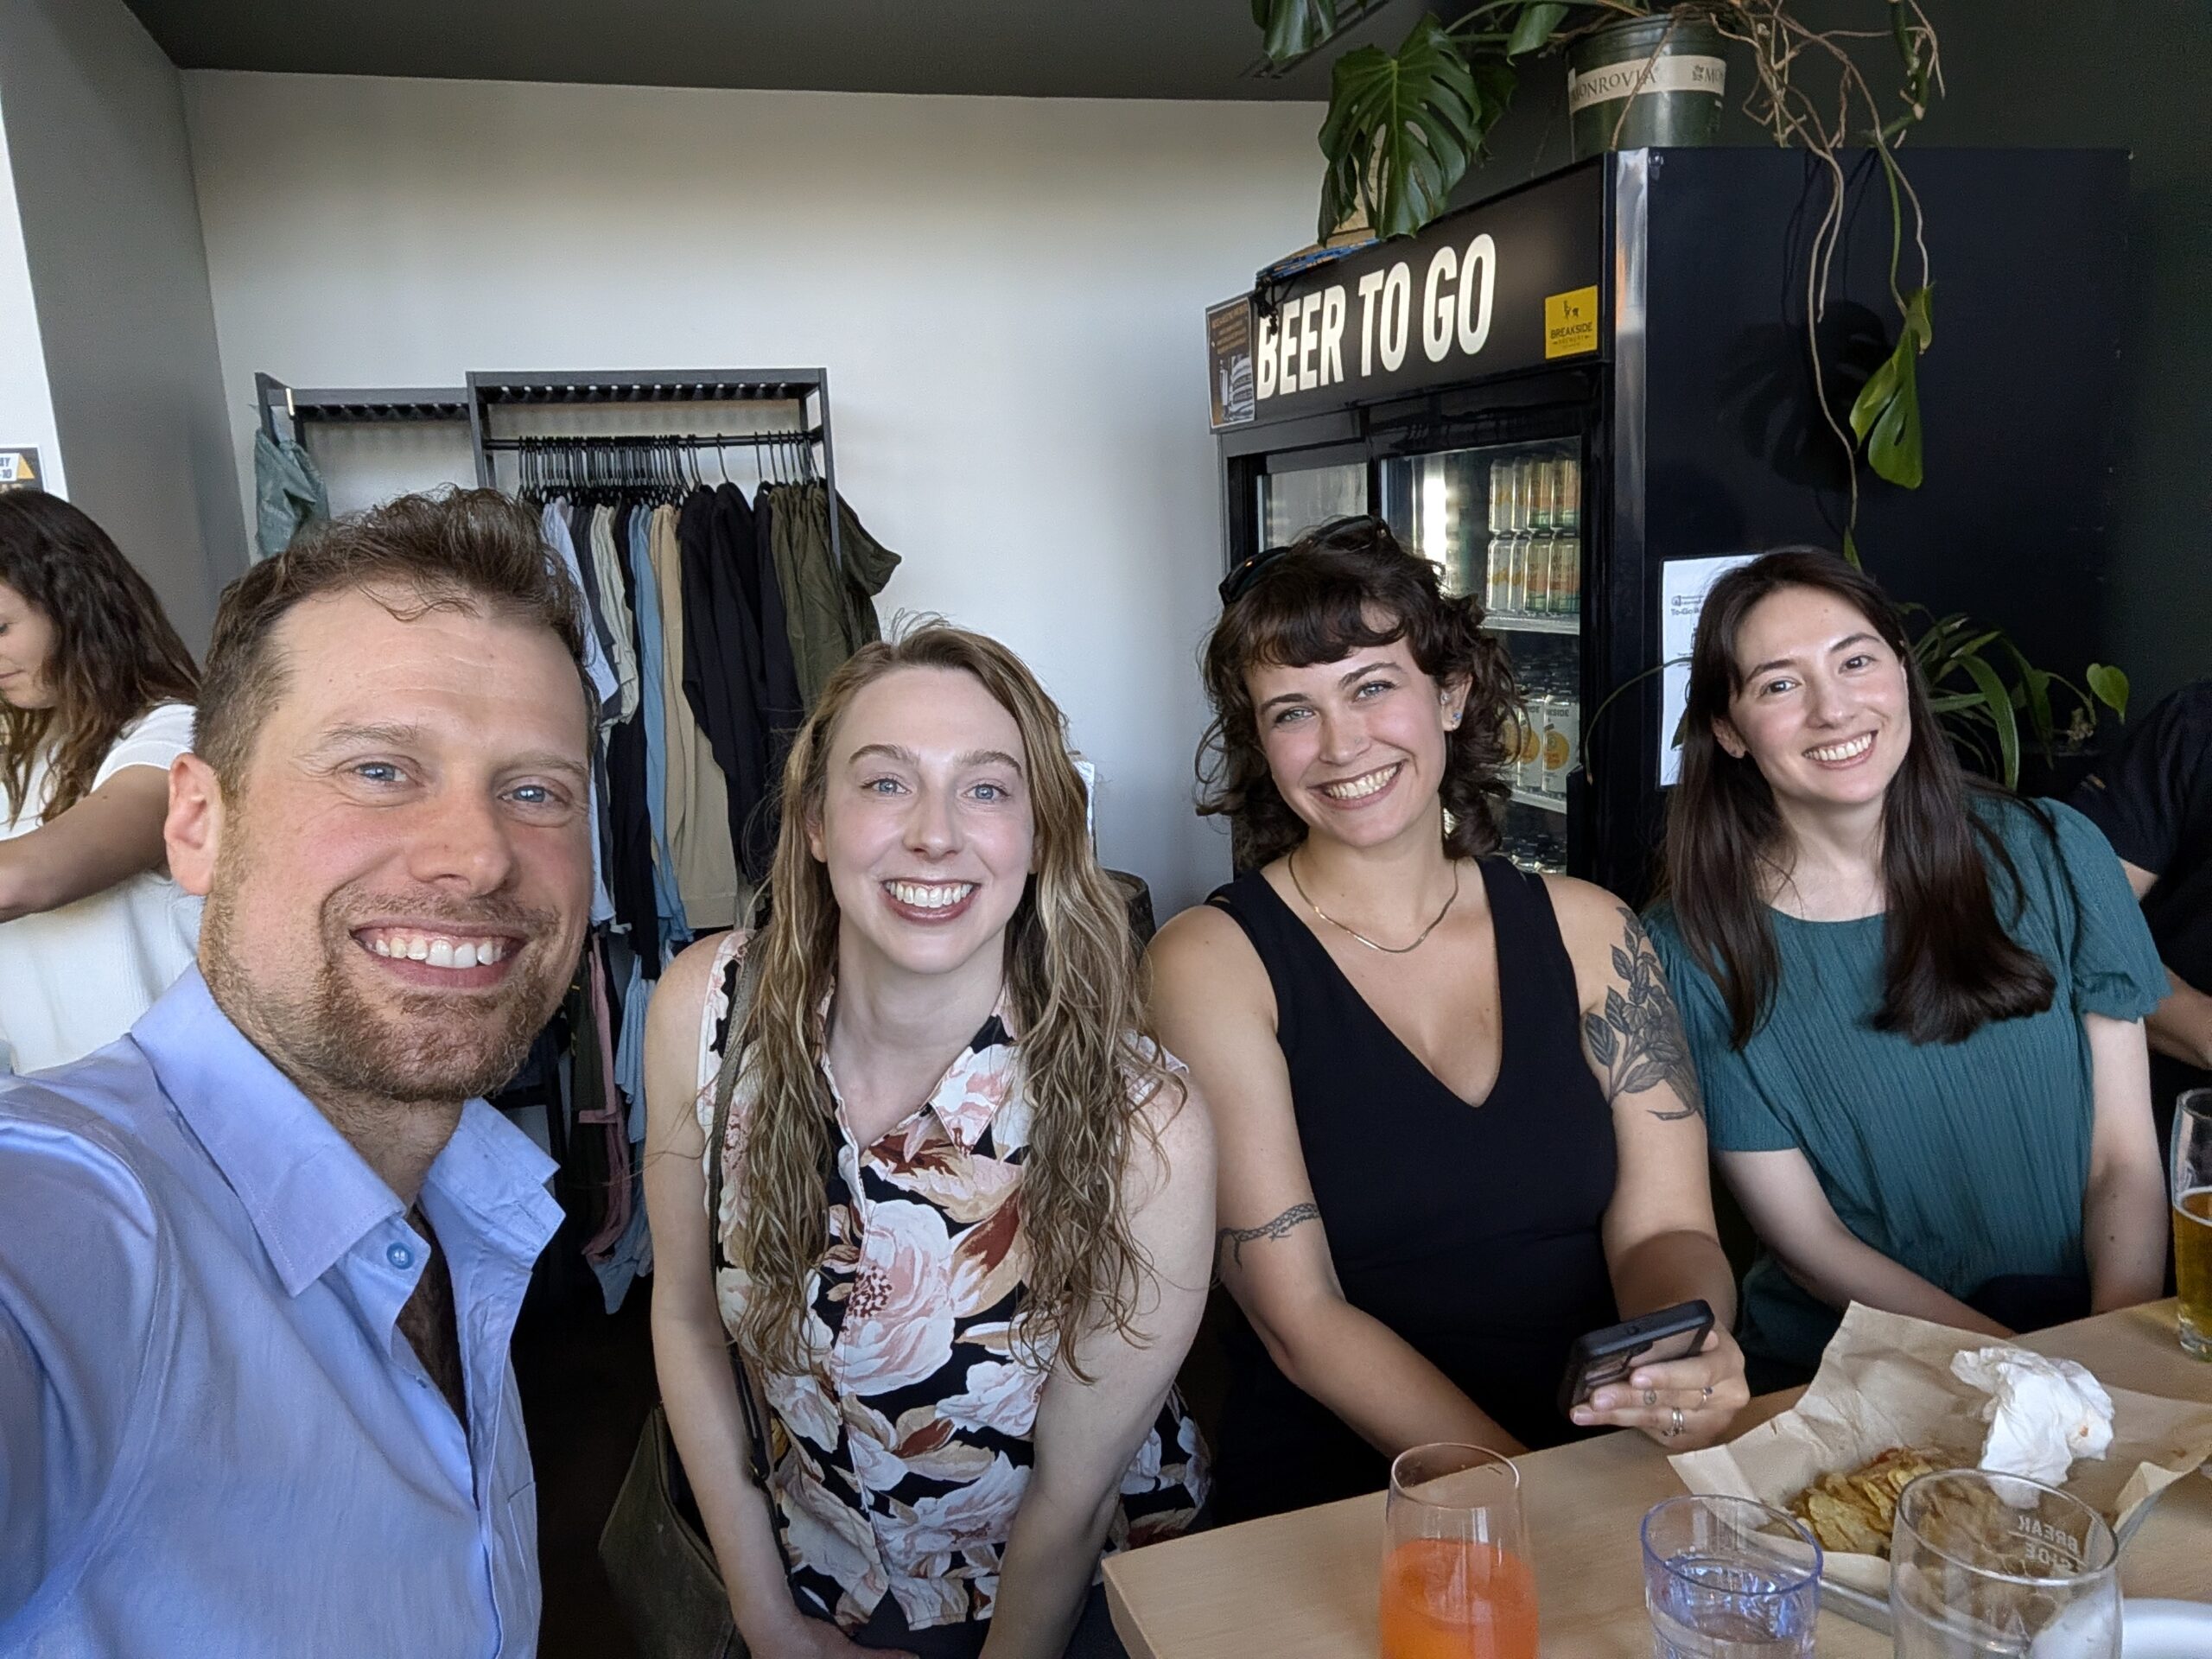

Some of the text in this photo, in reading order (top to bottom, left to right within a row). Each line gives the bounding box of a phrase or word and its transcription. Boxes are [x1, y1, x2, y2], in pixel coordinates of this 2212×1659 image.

[1256, 233, 1496, 400] BEER TO GO
[1550, 321, 1592, 339] BREAKSIDE
